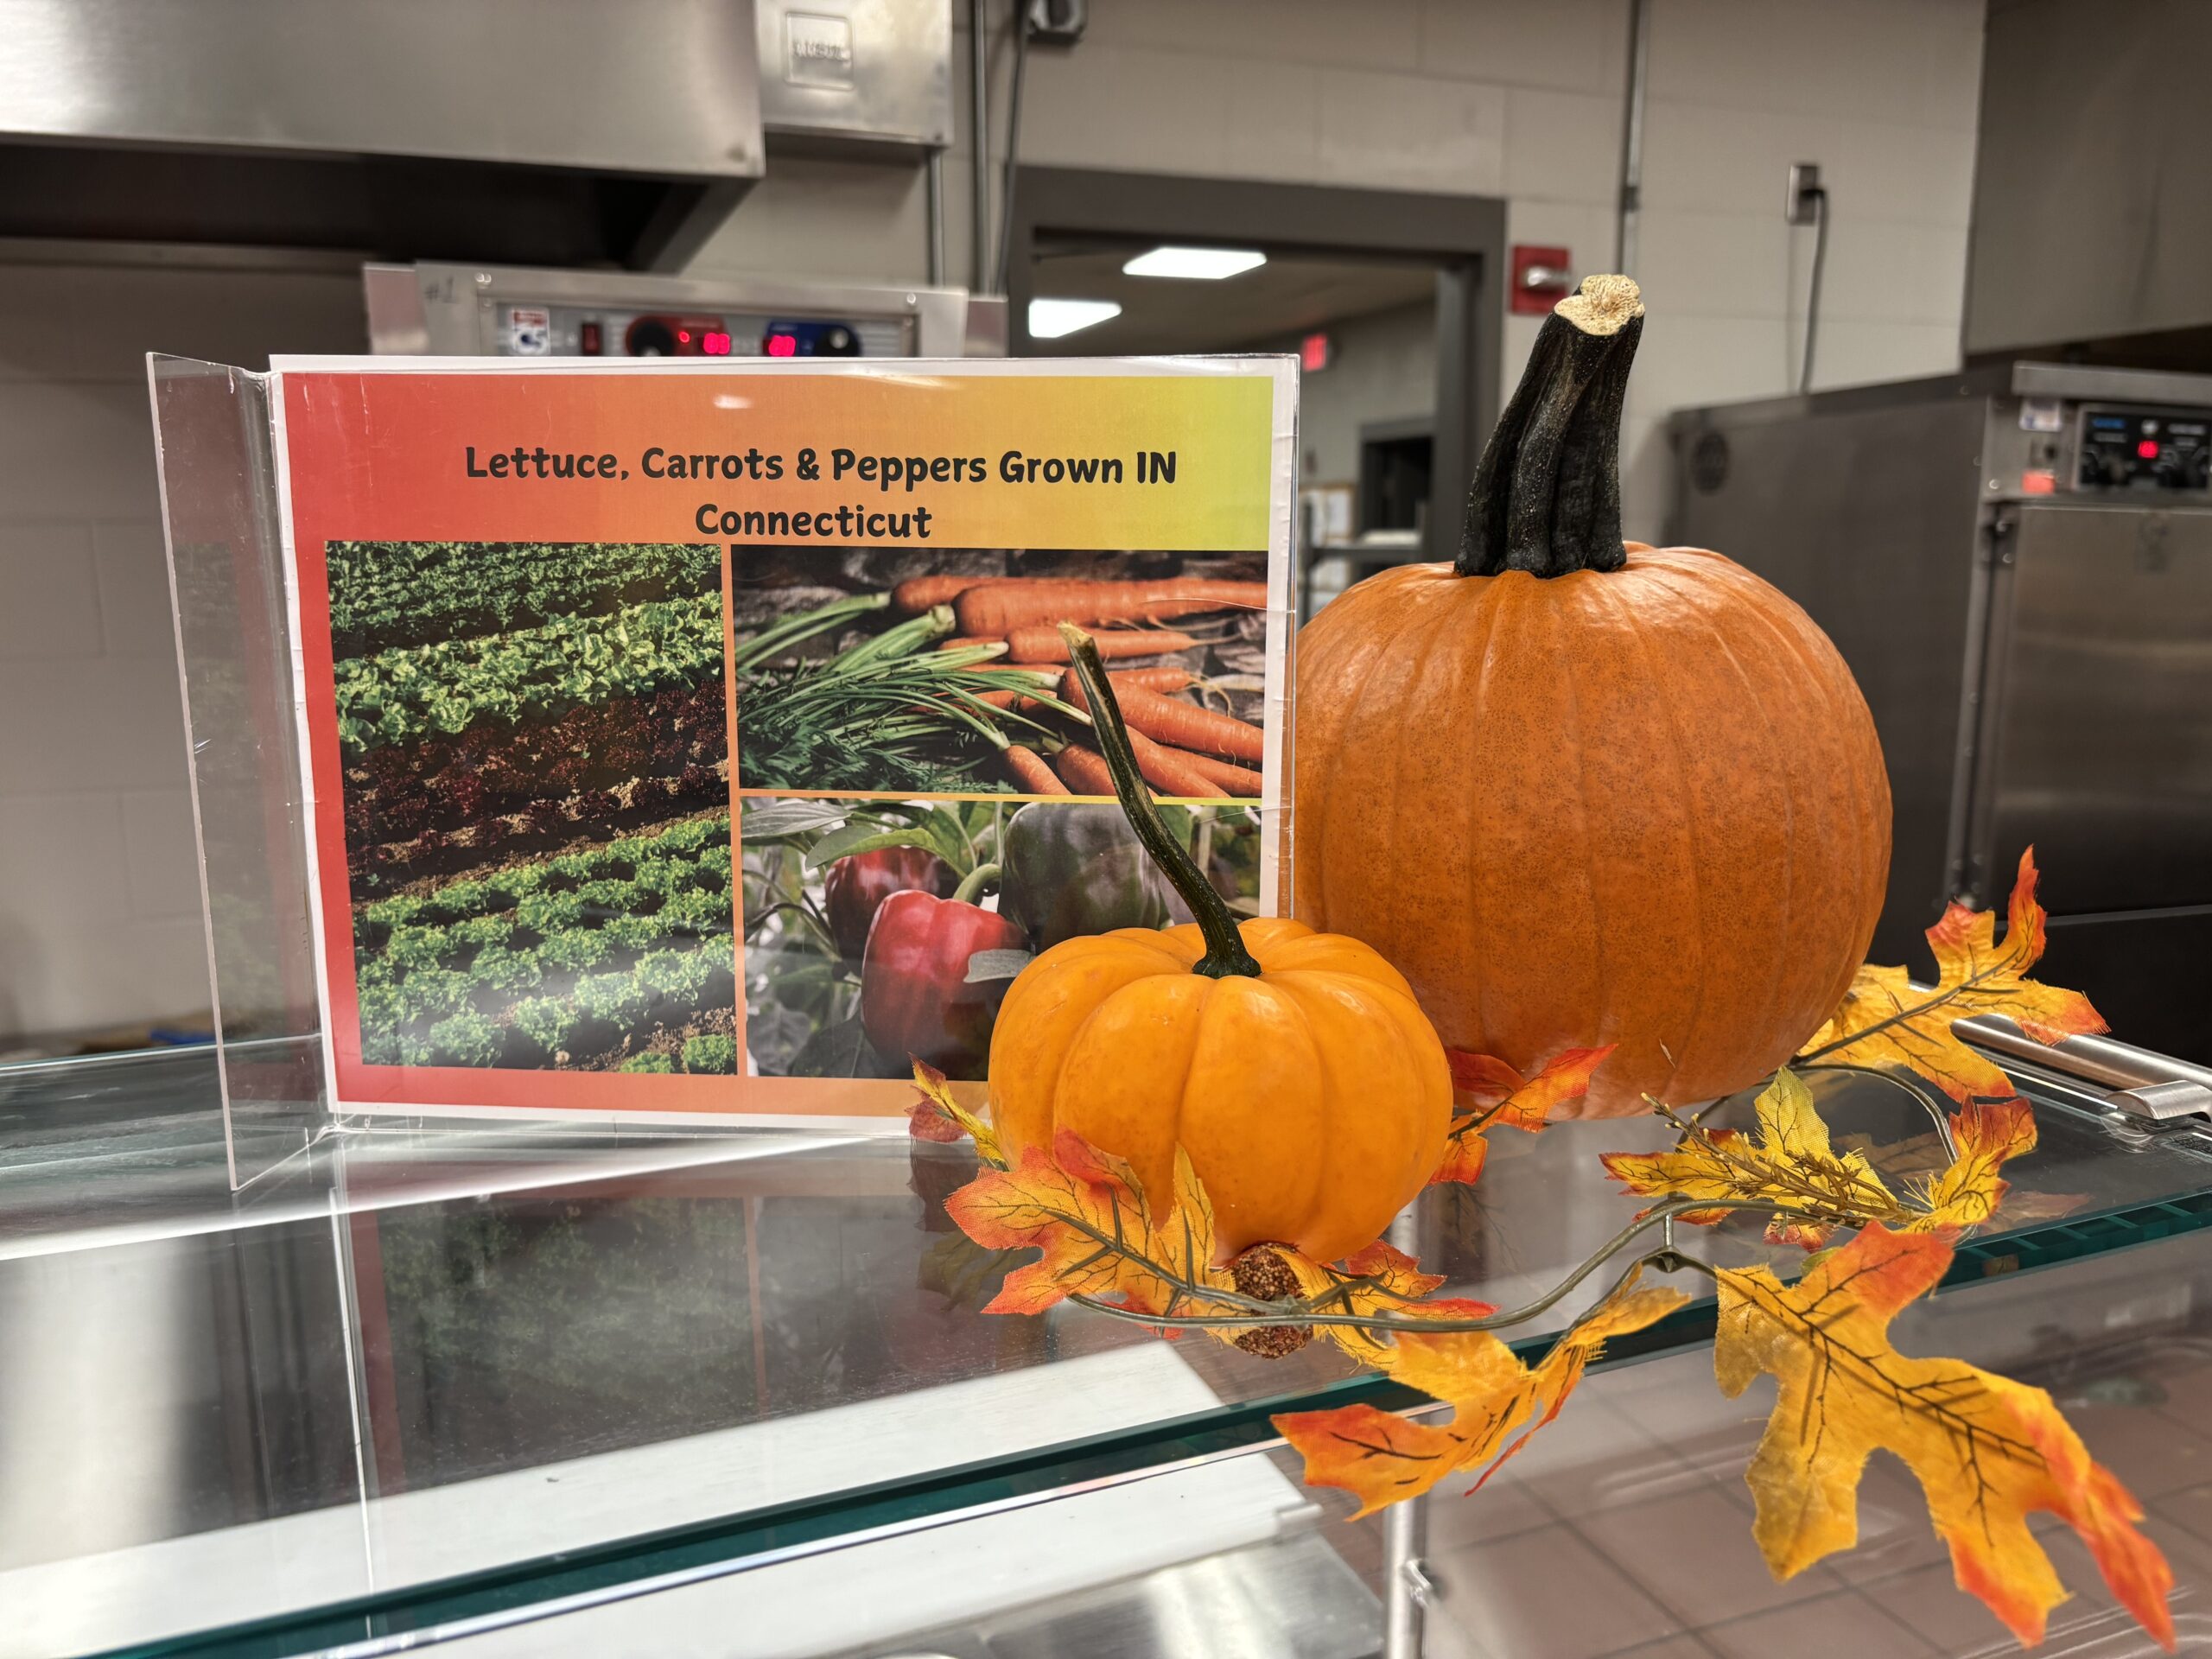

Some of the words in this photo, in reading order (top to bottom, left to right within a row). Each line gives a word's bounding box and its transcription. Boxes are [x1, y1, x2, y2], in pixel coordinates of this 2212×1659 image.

[466, 446, 630, 481] Lettuce,
[640, 447, 785, 481] Carrots
[795, 447, 821, 481] &
[830, 448, 988, 493] Peppers
[998, 449, 1124, 485] Grown
[1135, 450, 1177, 485] IN
[695, 503, 933, 539] Connecticut
